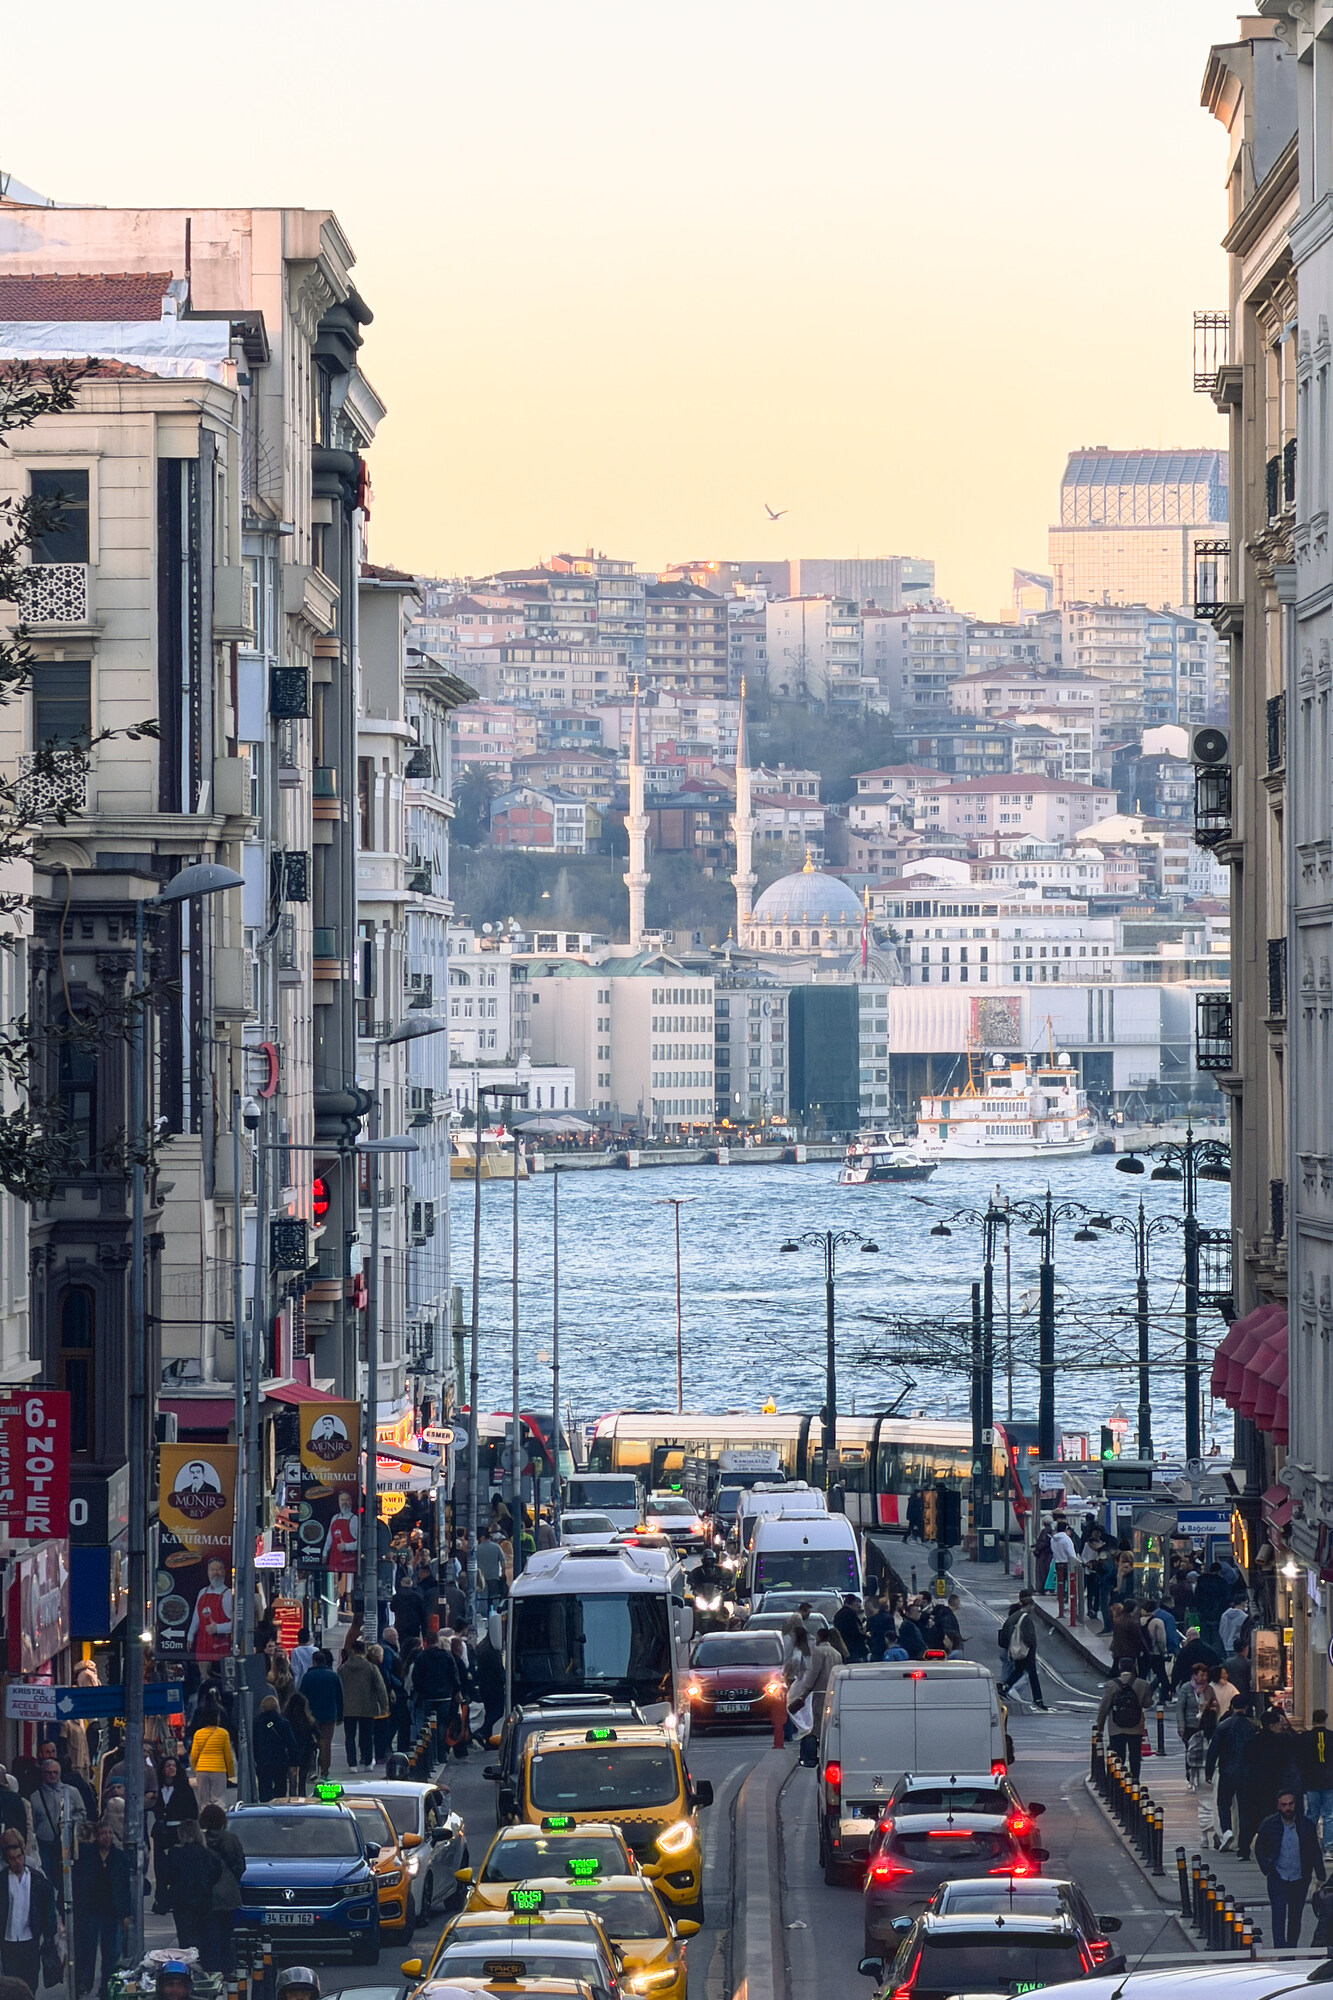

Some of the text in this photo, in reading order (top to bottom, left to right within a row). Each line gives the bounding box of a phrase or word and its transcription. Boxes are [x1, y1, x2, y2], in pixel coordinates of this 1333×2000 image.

[426, 1431, 451, 1439] ESMER
[24, 1398, 57, 1533] 6. NOTER
[162, 1534, 231, 1545] KAVURMACI
[161, 1641, 183, 1649] 150m
[266, 1913, 276, 1923] 34
[298, 1913, 312, 1923] 162
